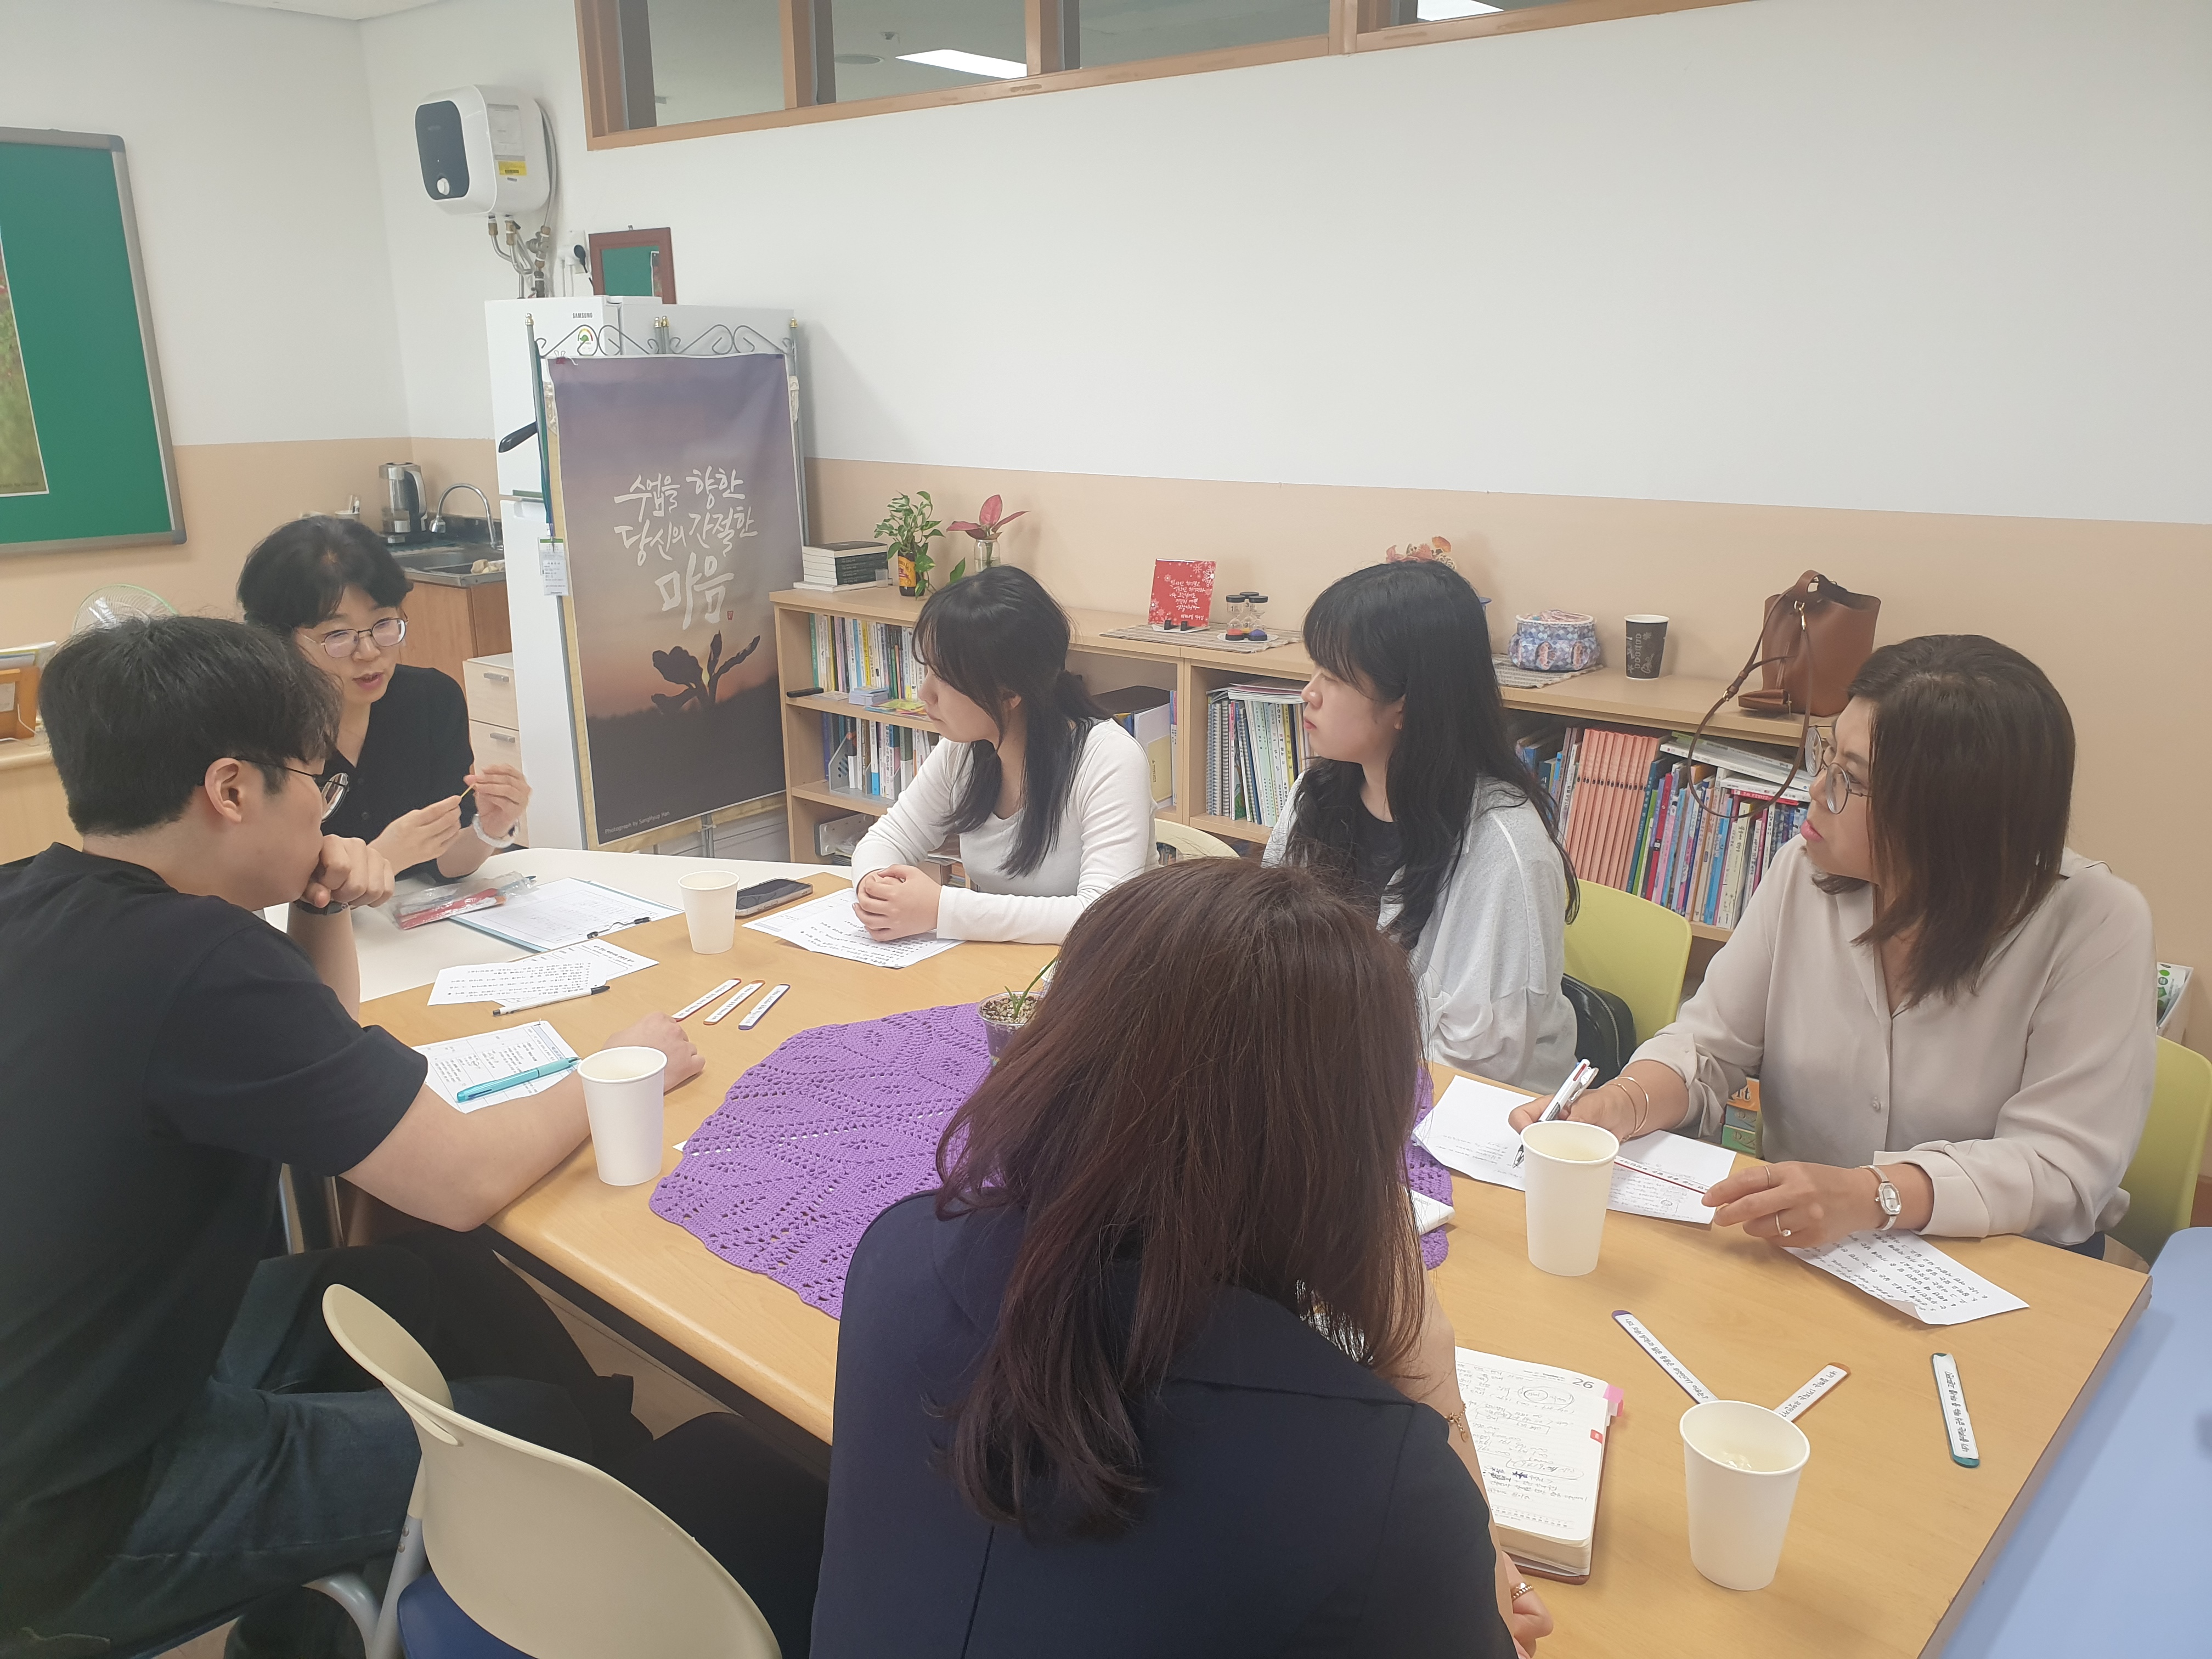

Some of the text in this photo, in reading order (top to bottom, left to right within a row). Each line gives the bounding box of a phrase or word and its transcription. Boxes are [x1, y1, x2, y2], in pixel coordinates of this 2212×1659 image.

[614, 466, 746, 522] 수업을 향한
[614, 506, 758, 566] 당신의 간절한
[654, 551, 735, 630] 마음
[605, 823, 632, 834] Photograph
[1871, 1251, 1887, 1261] 기억에
[1862, 1263, 1877, 1272] 친구는
[1900, 1262, 1929, 1280] 무엇인가요?
[1905, 1274, 1923, 1285] 있었던
[1892, 1283, 1908, 1293] 지내고
[1932, 1282, 1948, 1293] 이유는
[1906, 1285, 1937, 1304] 무엇인가요?
[1932, 1292, 1948, 1301] 4학년
[1660, 1356, 1674, 1366] 동물은
[1692, 1385, 1708, 1398] 이유는?
[1813, 1378, 1829, 1387] 잘하는
[1945, 1372, 1955, 1389] 고른다면?
[1572, 1378, 1595, 1390] 26
[1949, 1390, 1957, 1401] 하나를
[1779, 1401, 1801, 1417] 무엇인가?
[1958, 1427, 1969, 1442] 좋아하는
[1961, 1441, 1969, 1452] 내가
